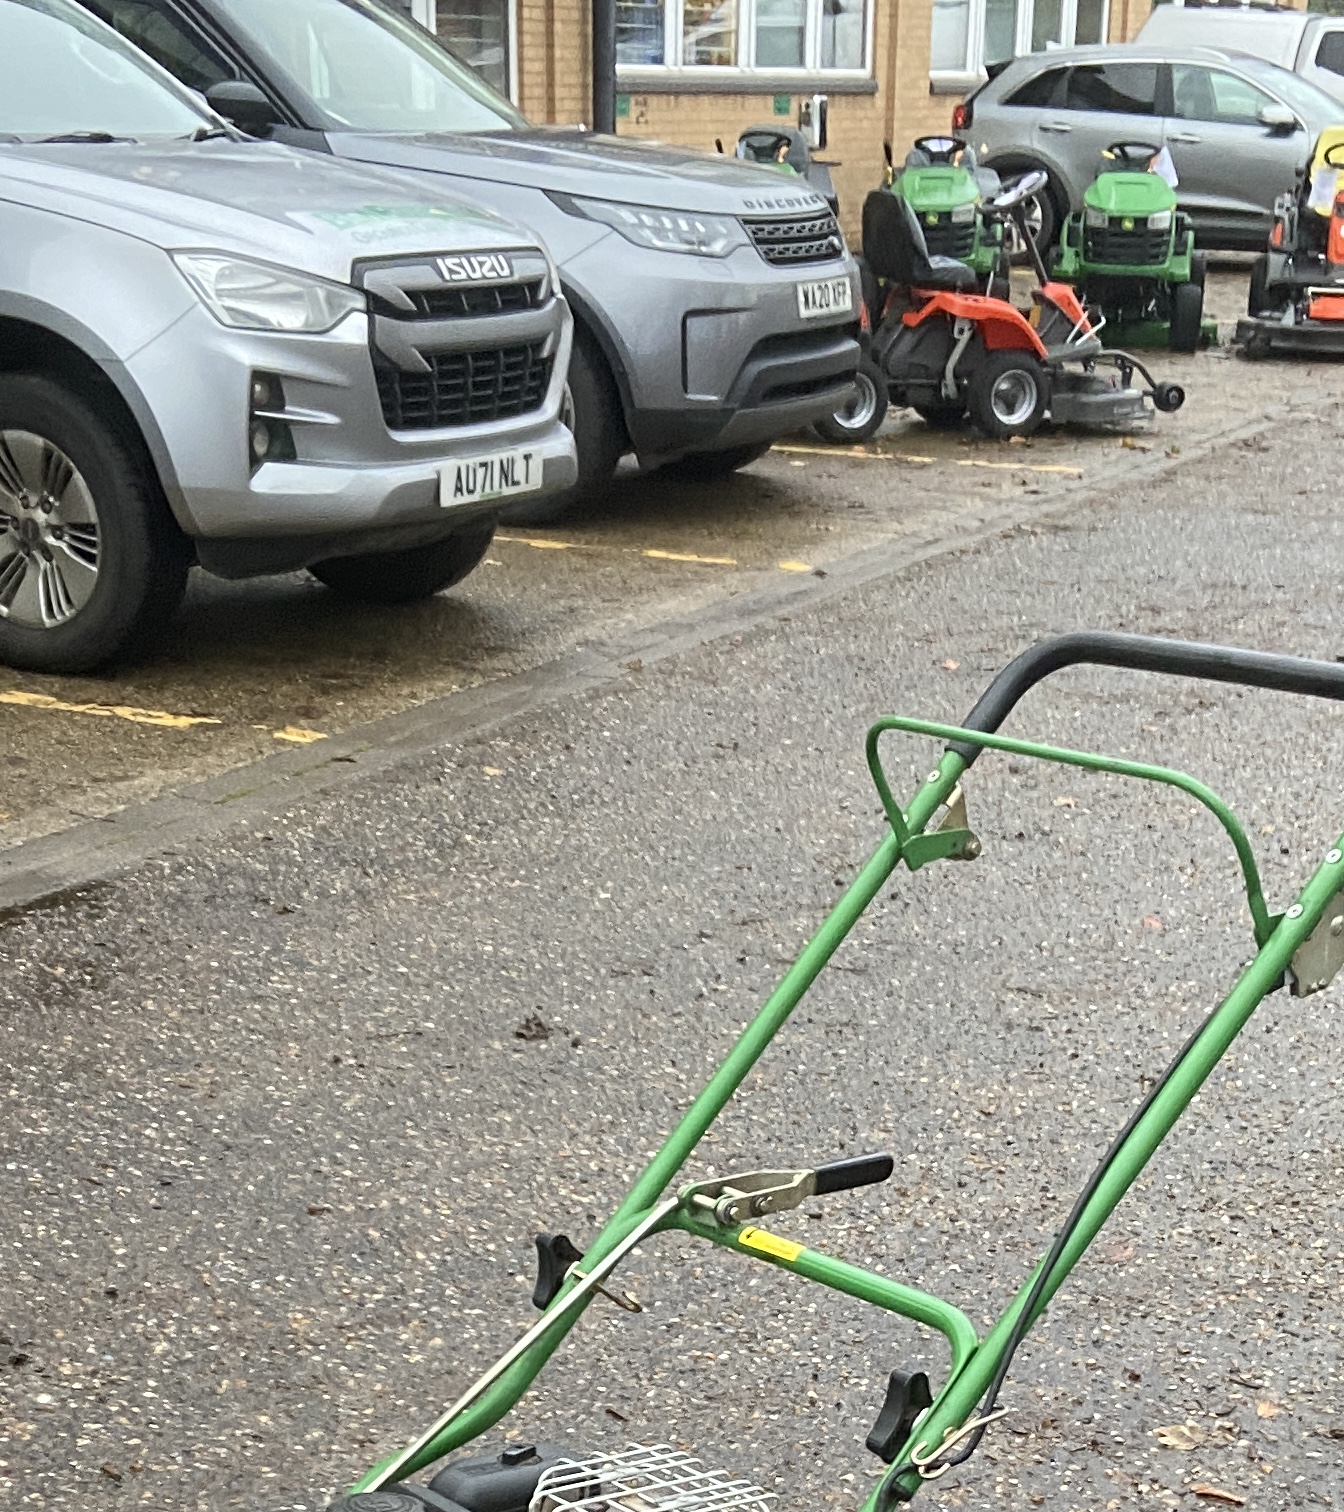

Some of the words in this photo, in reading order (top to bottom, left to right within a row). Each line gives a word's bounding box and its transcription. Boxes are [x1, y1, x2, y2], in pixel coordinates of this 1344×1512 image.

[436, 254, 511, 281] ISUZU
[453, 461, 494, 498] AU71
[499, 453, 533, 489] NLT
